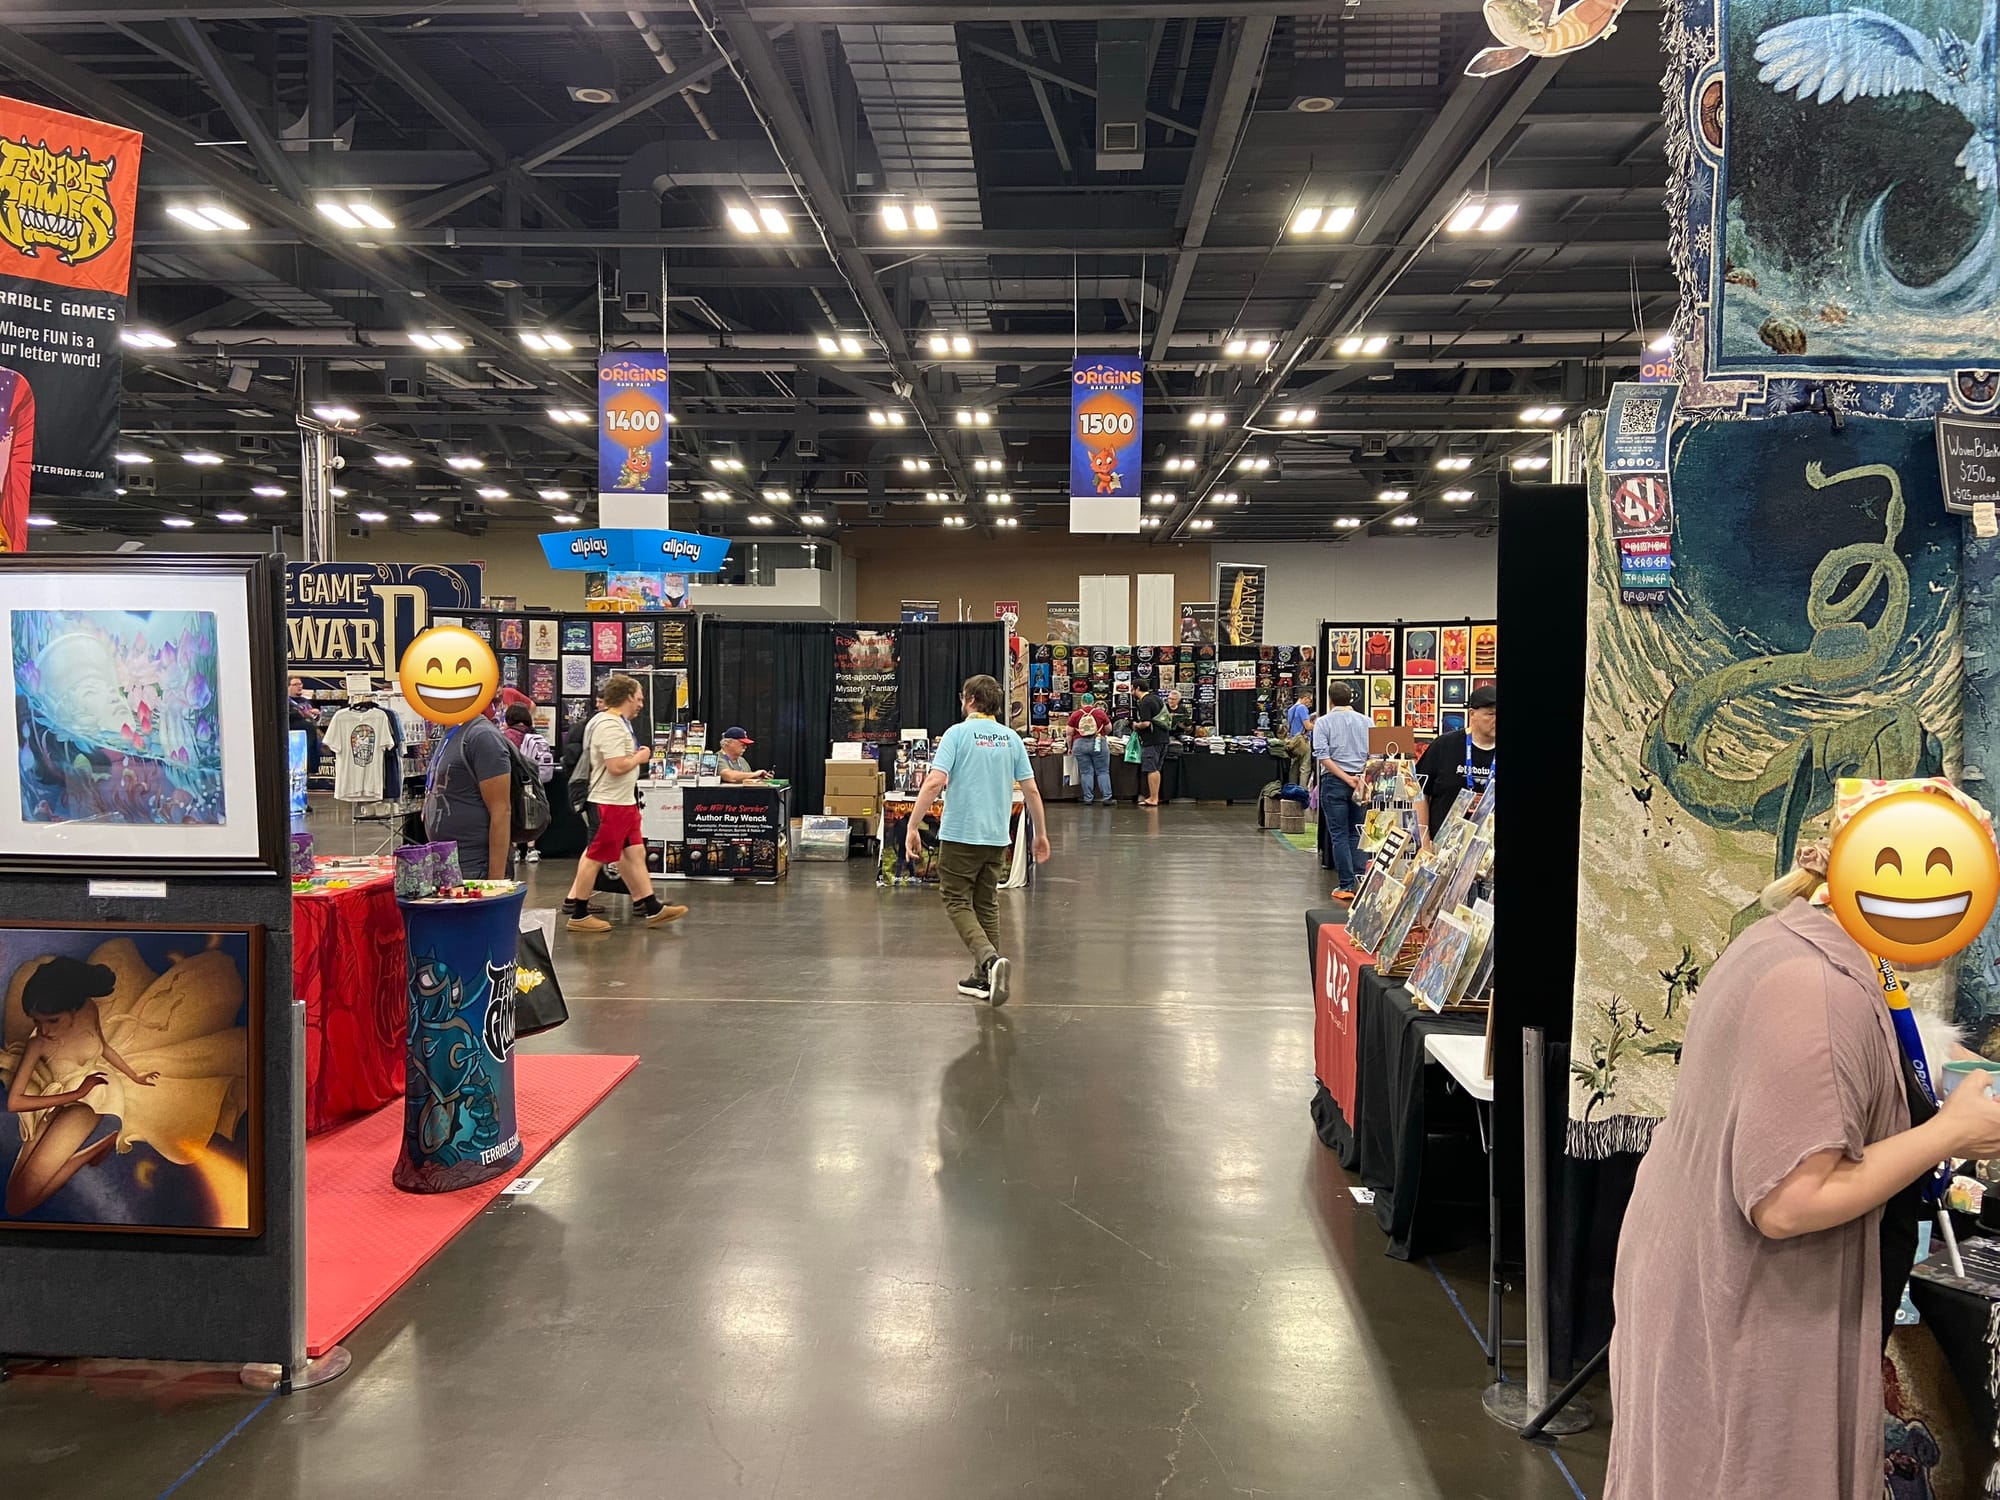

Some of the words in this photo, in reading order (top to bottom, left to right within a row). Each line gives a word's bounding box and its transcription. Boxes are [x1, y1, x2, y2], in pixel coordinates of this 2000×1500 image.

[61, 302, 116, 322] GAMES
[43, 328, 69, 346] FUN
[72, 332, 83, 347] is
[86, 336, 95, 348] a
[20, 343, 58, 363] letter
[61, 352, 101, 368] word!
[606, 410, 660, 432] 1400
[1079, 413, 1134, 435] 1500
[1946, 434, 1975, 456] Woven
[571, 537, 608, 558] allplay
[662, 539, 701, 561] allplay
[299, 572, 375, 605] GAME
[996, 605, 1018, 614] EXIT
[835, 672, 896, 682] Post-apocalyptic
[835, 684, 866, 694] Mystery
[870, 684, 899, 694] Fantasy
[695, 813, 723, 822] Author
[723, 813, 739, 824] Ray
[740, 814, 767, 822] Wenck
